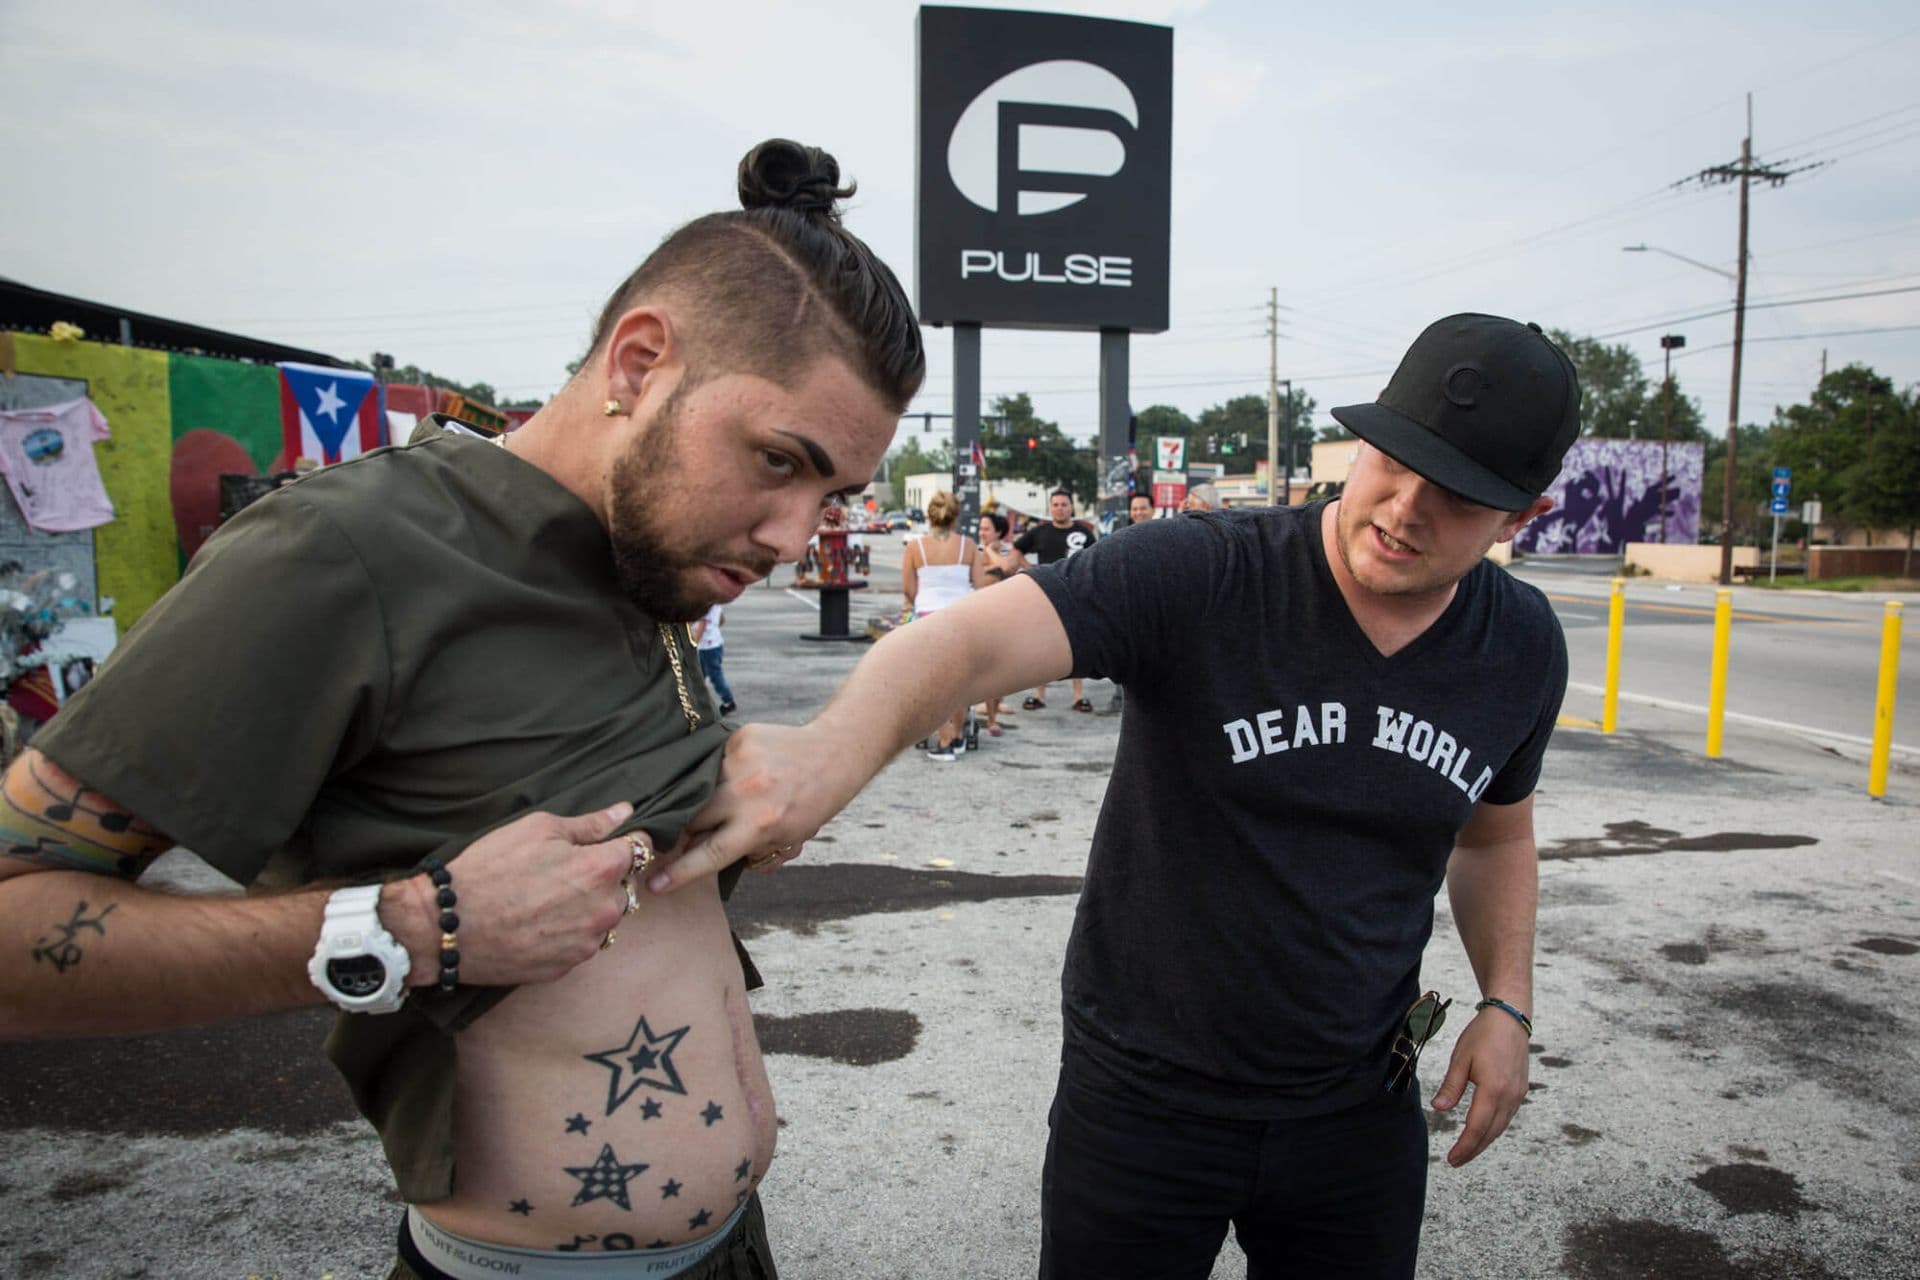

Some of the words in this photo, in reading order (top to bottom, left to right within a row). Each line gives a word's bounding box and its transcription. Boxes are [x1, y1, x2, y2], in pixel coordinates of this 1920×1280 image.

[961, 249, 1133, 287] PULSE
[1222, 702, 1347, 764] DEAR
[1371, 705, 1494, 804] WORLD
[420, 1220, 454, 1255] FRUIT
[468, 1253, 522, 1275] LOOM
[646, 1256, 686, 1273] FRUIT
